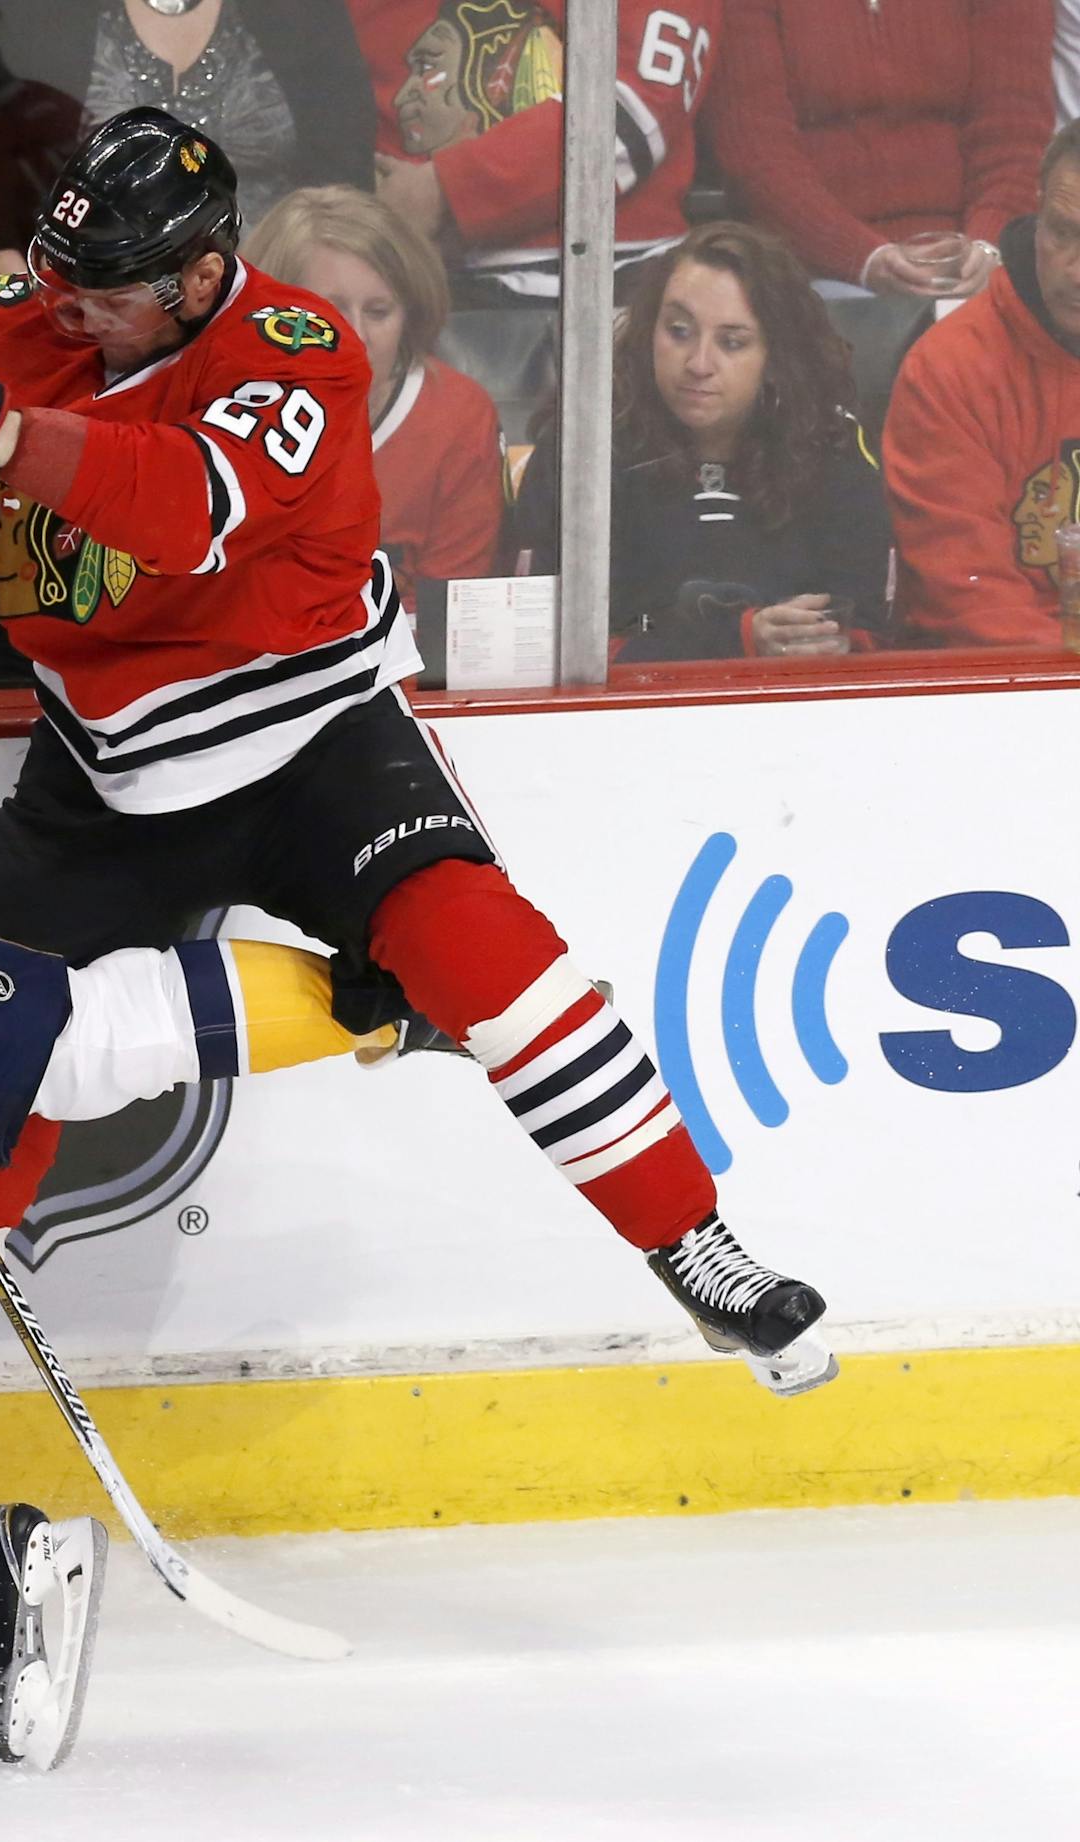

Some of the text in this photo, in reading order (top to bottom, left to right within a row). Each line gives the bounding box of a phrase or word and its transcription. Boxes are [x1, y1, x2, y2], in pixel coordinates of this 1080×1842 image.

[52, 189, 90, 229] 29
[201, 380, 326, 475] 29
[5, 1271, 102, 1445] SUPREM
